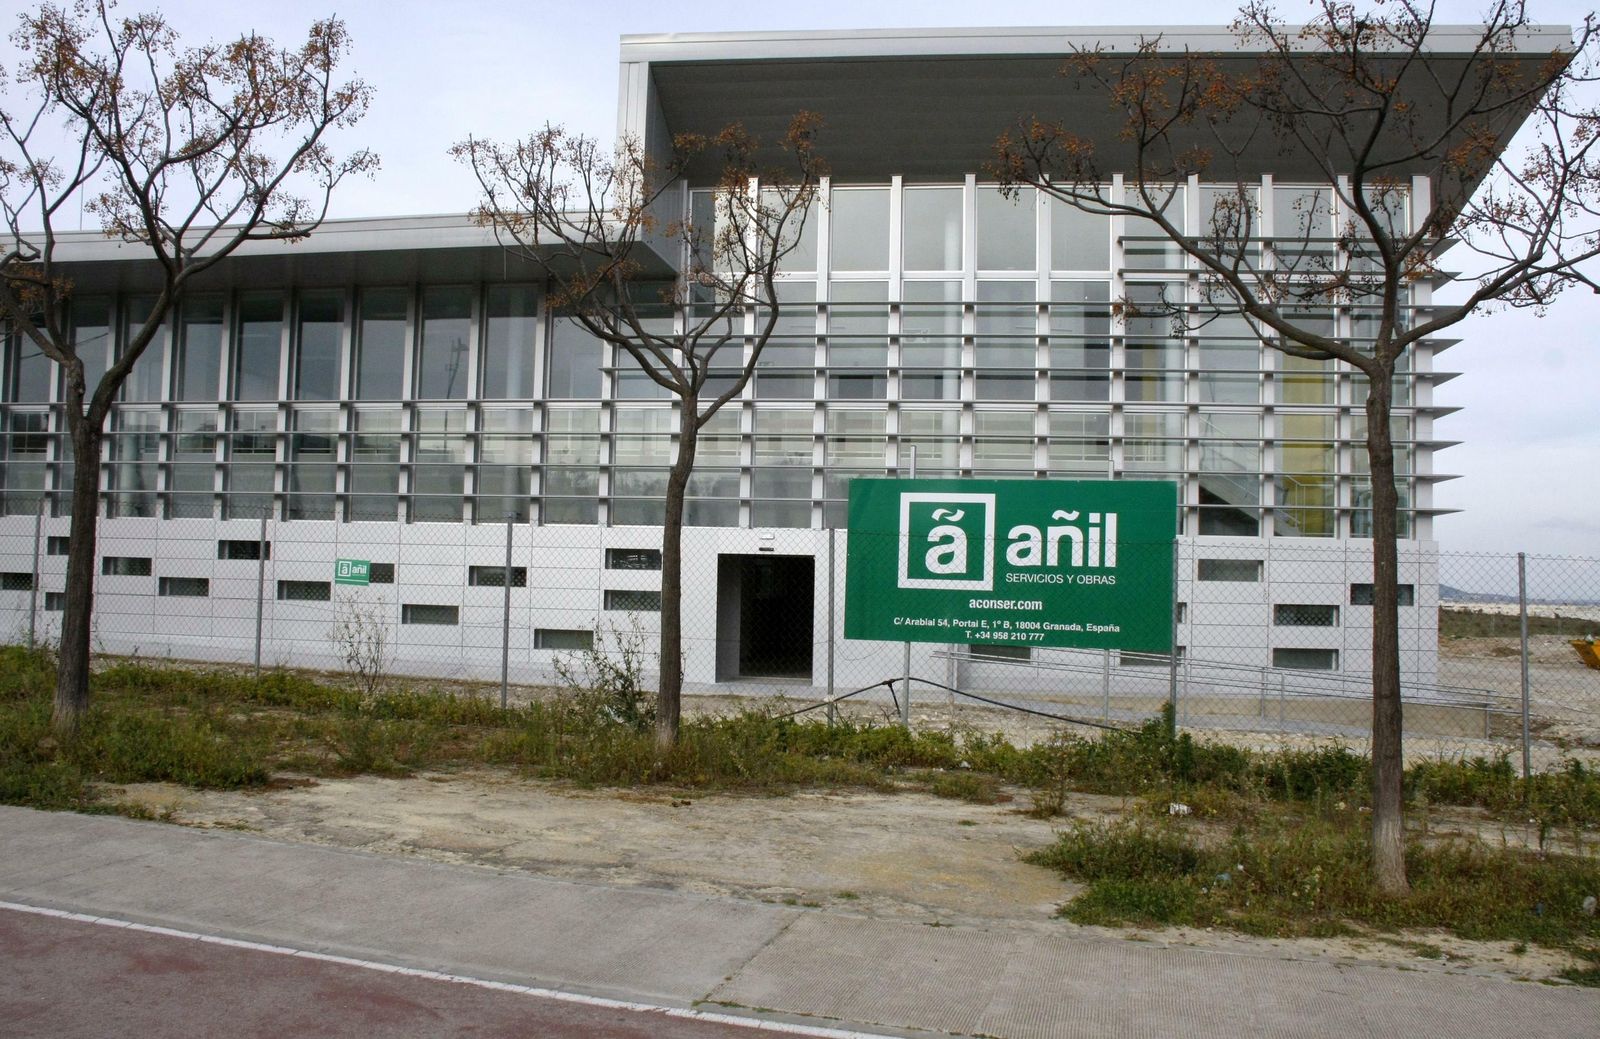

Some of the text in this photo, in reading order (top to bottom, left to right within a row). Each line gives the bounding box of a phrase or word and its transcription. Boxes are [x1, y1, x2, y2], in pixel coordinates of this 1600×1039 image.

[1005, 509, 1117, 568] añil
[1005, 573, 1116, 585] SERVICIOS Y OBRAS
[969, 599, 1043, 610] aconser.com
[893, 617, 904, 625] C/
[904, 618, 935, 626] Arabial
[937, 619, 951, 628] 54,
[952, 619, 979, 628] Portal
[981, 620, 990, 629] E,
[1003, 621, 1012, 630] B,
[1015, 621, 1041, 630] 18004
[1042, 622, 1084, 632] Granada,
[1086, 623, 1120, 633] España
[965, 630, 1045, 641] T. +34 958 210 777
